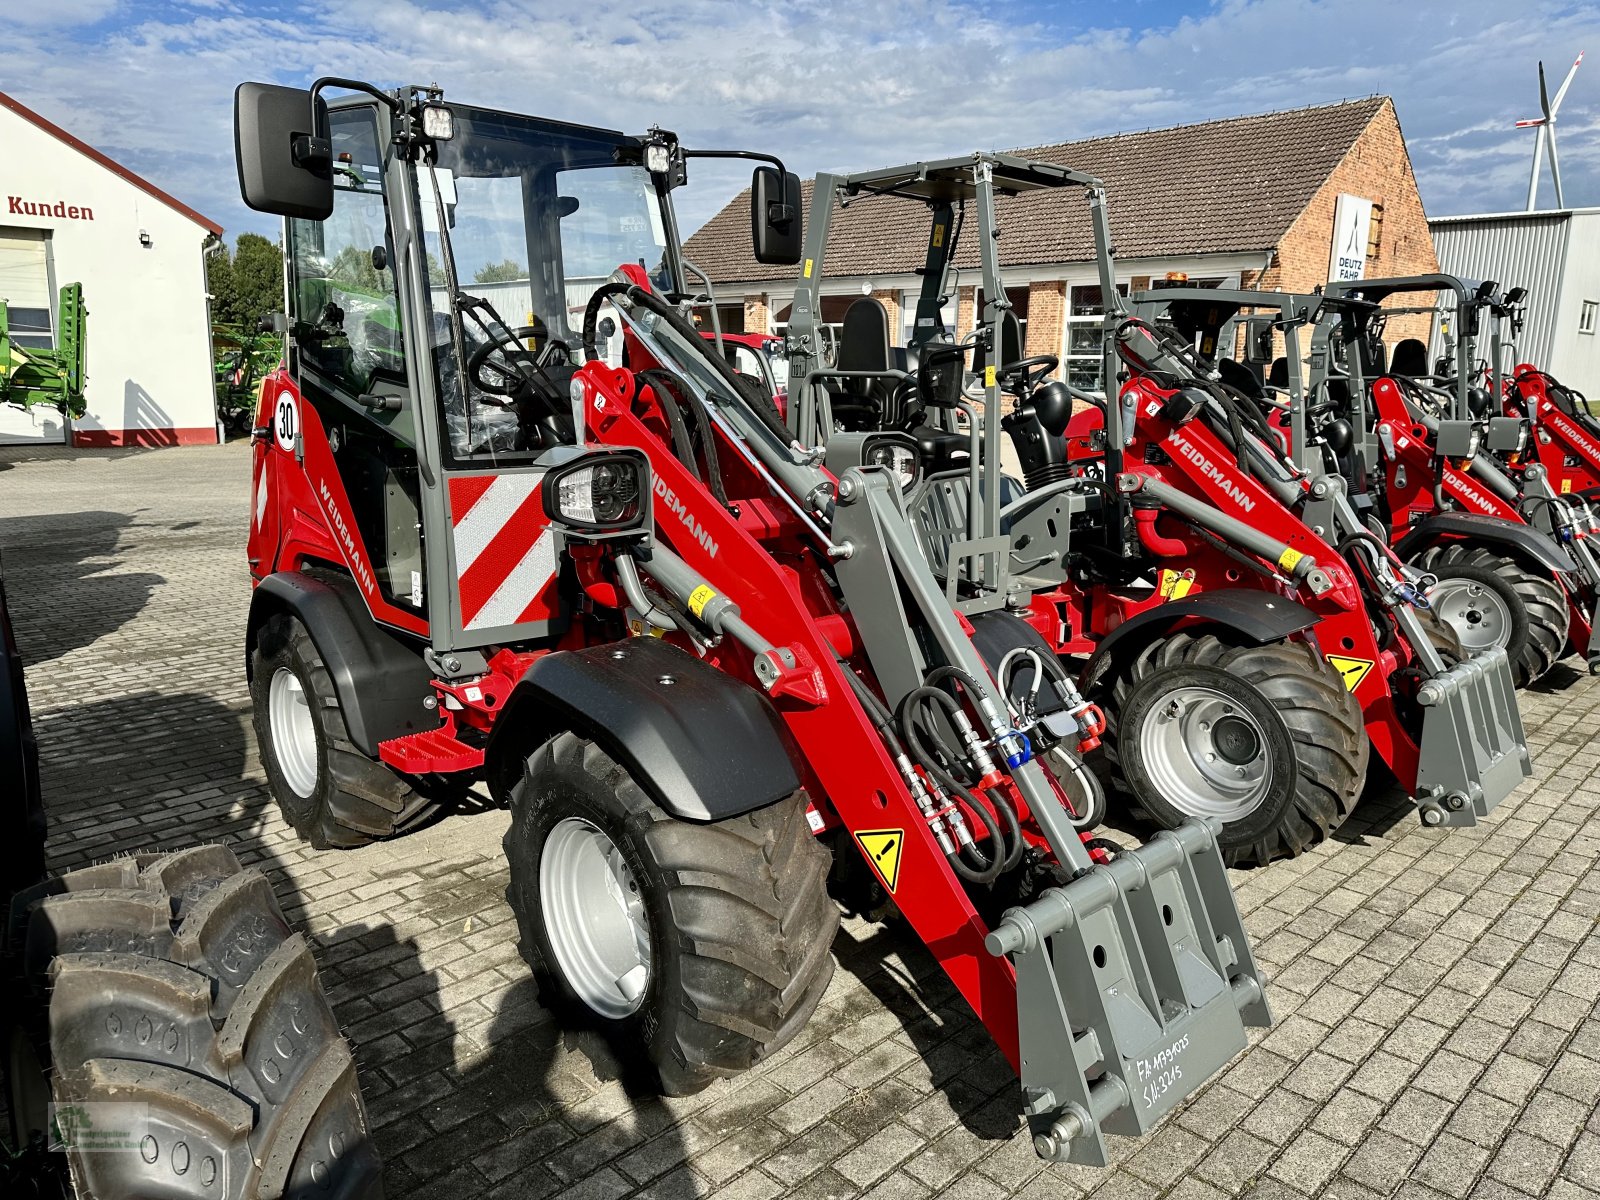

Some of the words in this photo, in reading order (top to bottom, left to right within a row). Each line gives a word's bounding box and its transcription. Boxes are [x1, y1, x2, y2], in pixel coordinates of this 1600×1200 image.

[7, 195, 94, 221] Kunden
[1339, 257, 1362, 270] DEUTZ
[1340, 269, 1359, 280] FAHR
[279, 402, 294, 441] 30
[1168, 428, 1256, 513] WEIDEMANN
[1442, 468, 1497, 515] IDEMANN
[652, 467, 719, 559] IDEMANN
[319, 477, 374, 596] WEIDEMANN
